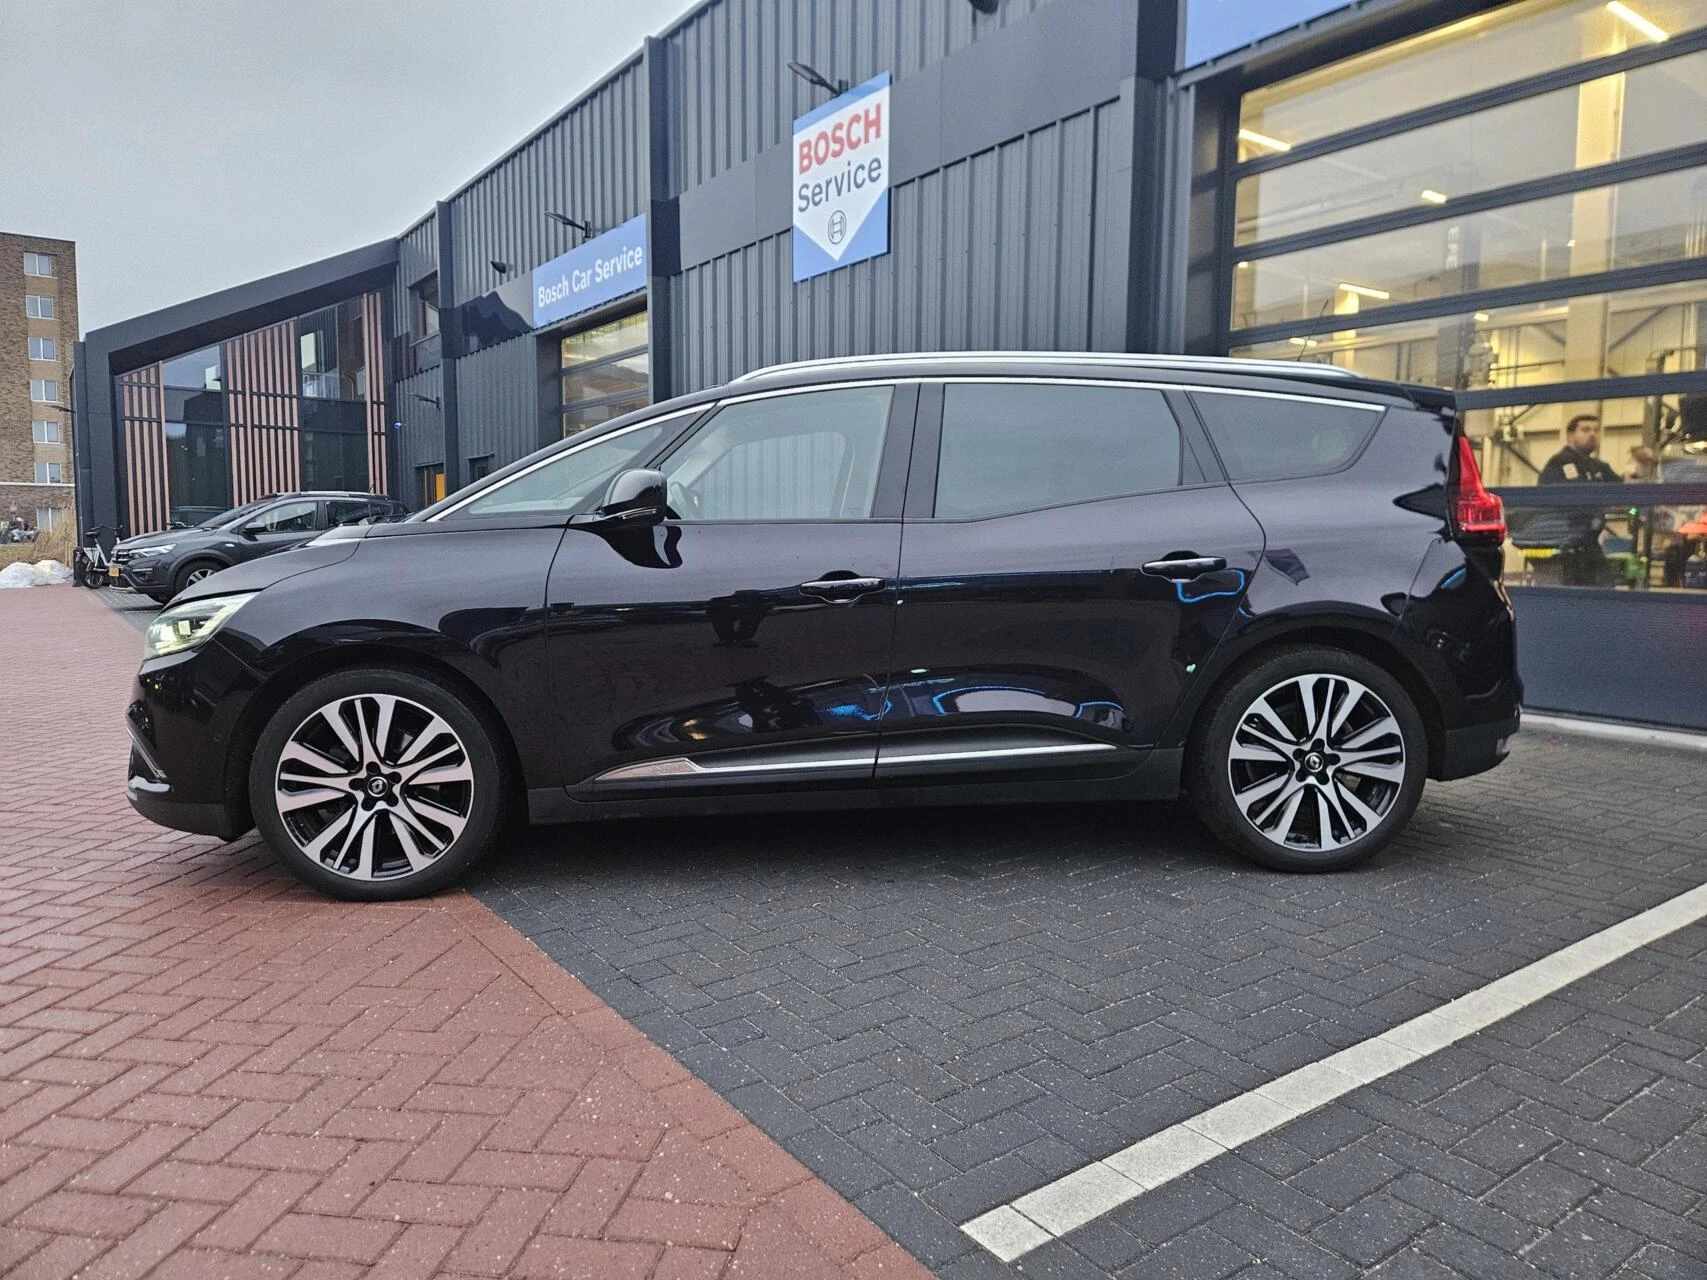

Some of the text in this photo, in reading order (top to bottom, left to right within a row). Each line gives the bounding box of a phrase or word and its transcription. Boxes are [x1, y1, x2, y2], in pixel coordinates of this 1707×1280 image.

[799, 103, 882, 175] BOSCH
[798, 157, 882, 213] Service
[538, 246, 642, 308] Bosch Car Service
